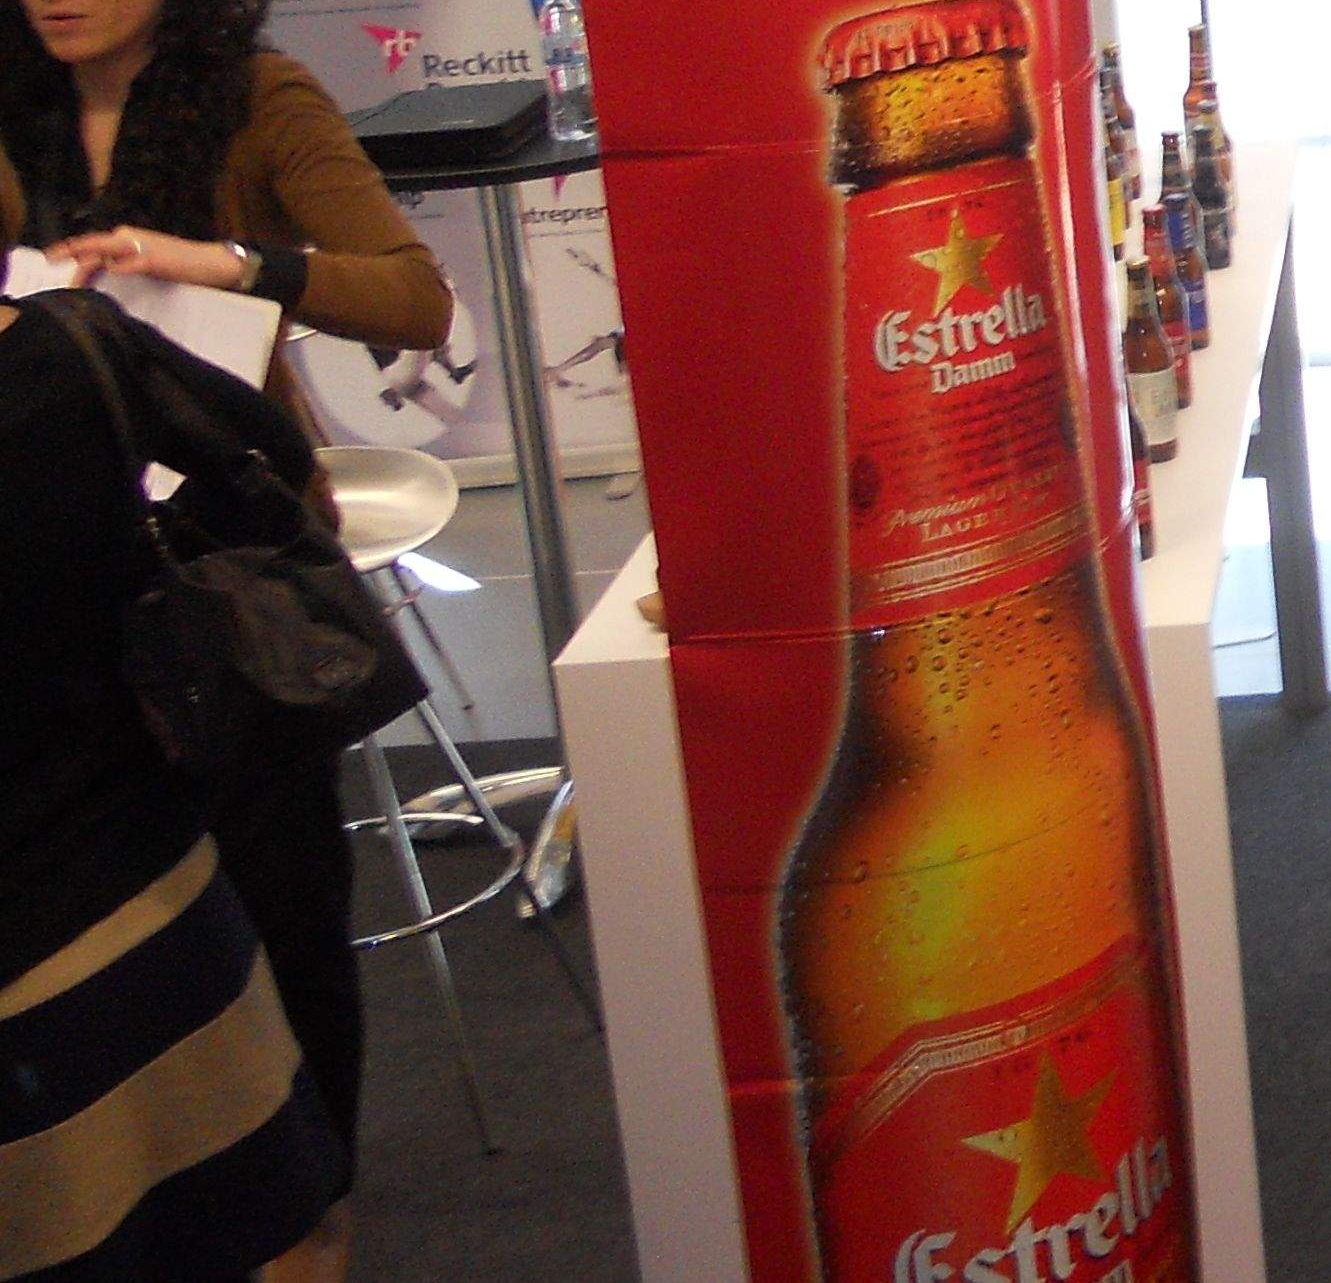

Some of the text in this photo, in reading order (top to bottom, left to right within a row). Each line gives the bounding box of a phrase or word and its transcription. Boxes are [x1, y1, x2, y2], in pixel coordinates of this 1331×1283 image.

[421, 50, 532, 77] Reckitt
[873, 283, 1048, 373] Estrella
[929, 351, 1017, 394] Damm
